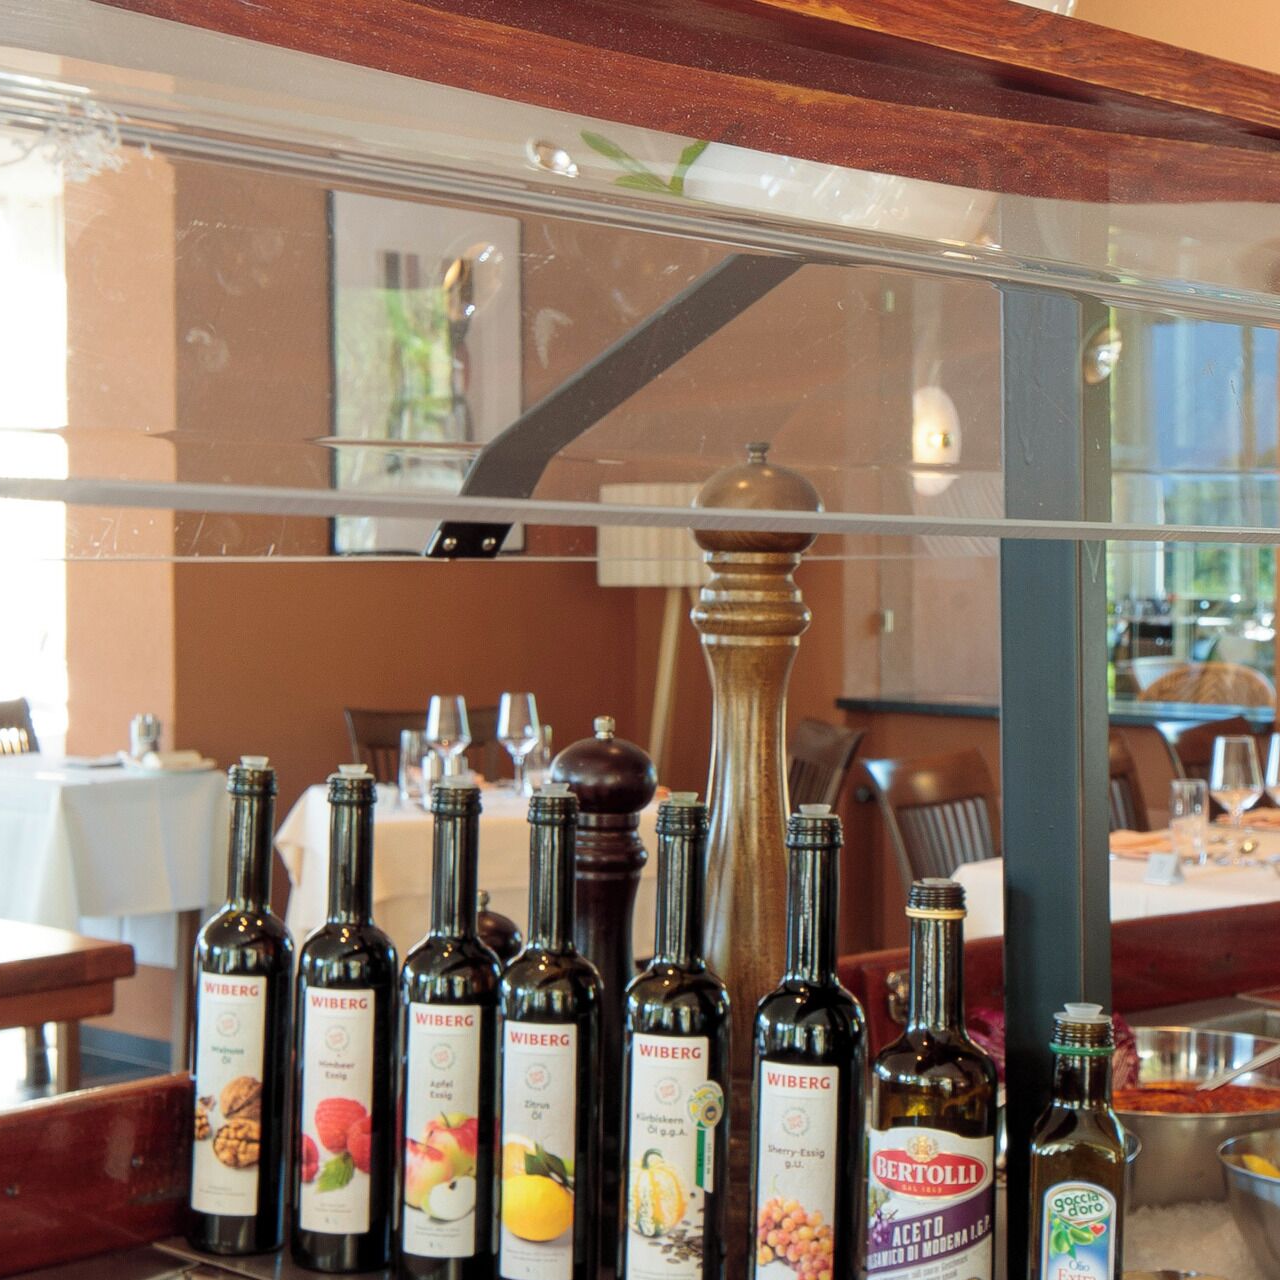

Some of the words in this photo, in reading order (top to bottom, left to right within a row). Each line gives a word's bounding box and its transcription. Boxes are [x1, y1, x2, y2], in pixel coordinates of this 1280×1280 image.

[204, 981, 260, 997] WIBERG
[311, 995, 368, 1010] WIBERG
[415, 1012, 474, 1028] WIBERG
[510, 1031, 570, 1047] WIBERG
[639, 1043, 702, 1060] WIBERG
[767, 1072, 832, 1090] WIBERG
[636, 1112, 684, 1125] Kürbiskern
[768, 1144, 826, 1159] Sherry-Essig
[875, 1155, 978, 1186] BERTOLLI
[1054, 1192, 1099, 1213] goccia
[1068, 1201, 1104, 1217] d'oro
[892, 1215, 944, 1248] ACETO
[907, 1244, 919, 1263] DI
[922, 1228, 969, 1259] MODENA
[1068, 1259, 1091, 1272] Olio
